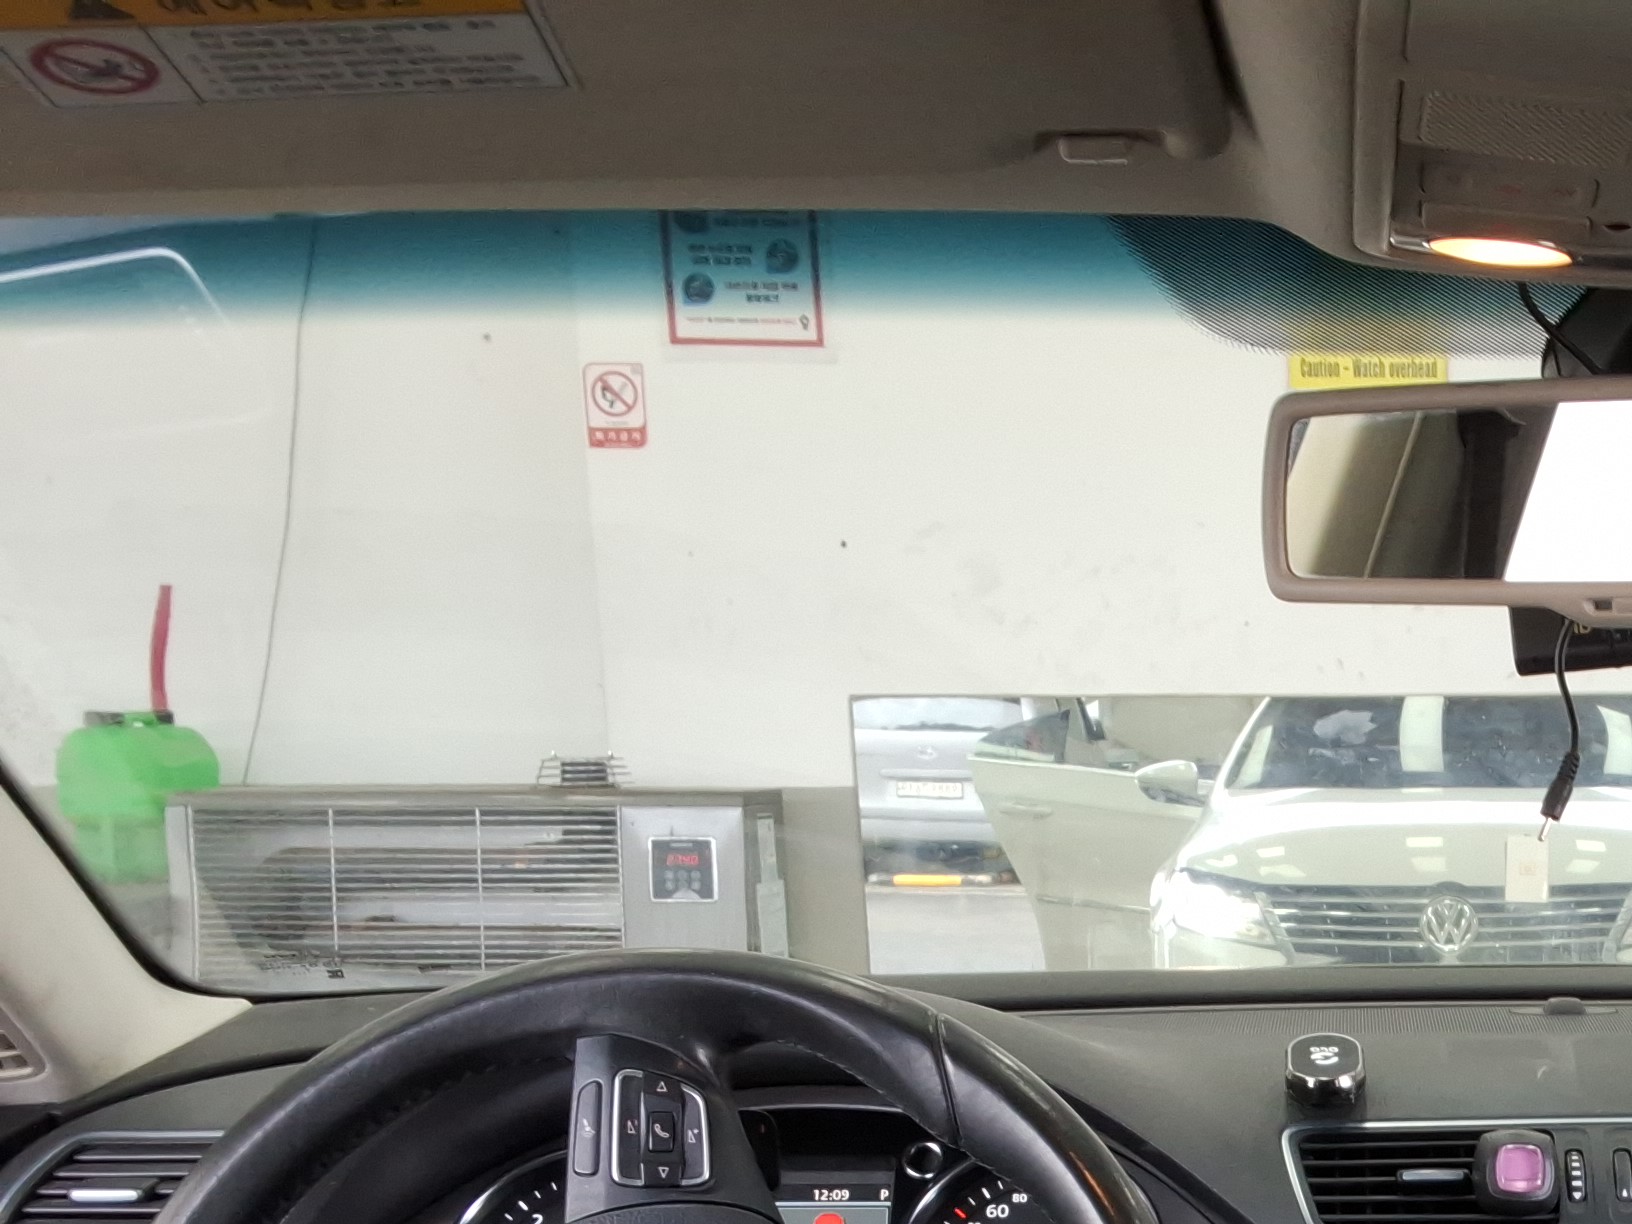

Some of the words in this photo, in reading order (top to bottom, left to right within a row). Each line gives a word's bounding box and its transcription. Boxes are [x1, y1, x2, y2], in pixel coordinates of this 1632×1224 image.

[1300, 357, 1340, 378] Caution
[1352, 357, 1386, 378] Watch
[1389, 357, 1438, 378] overhead
[813, 1189, 850, 1200] 12:09
[880, 1189, 889, 1200] P
[1012, 1193, 1027, 1203] 80
[986, 1205, 1009, 1218] 60
